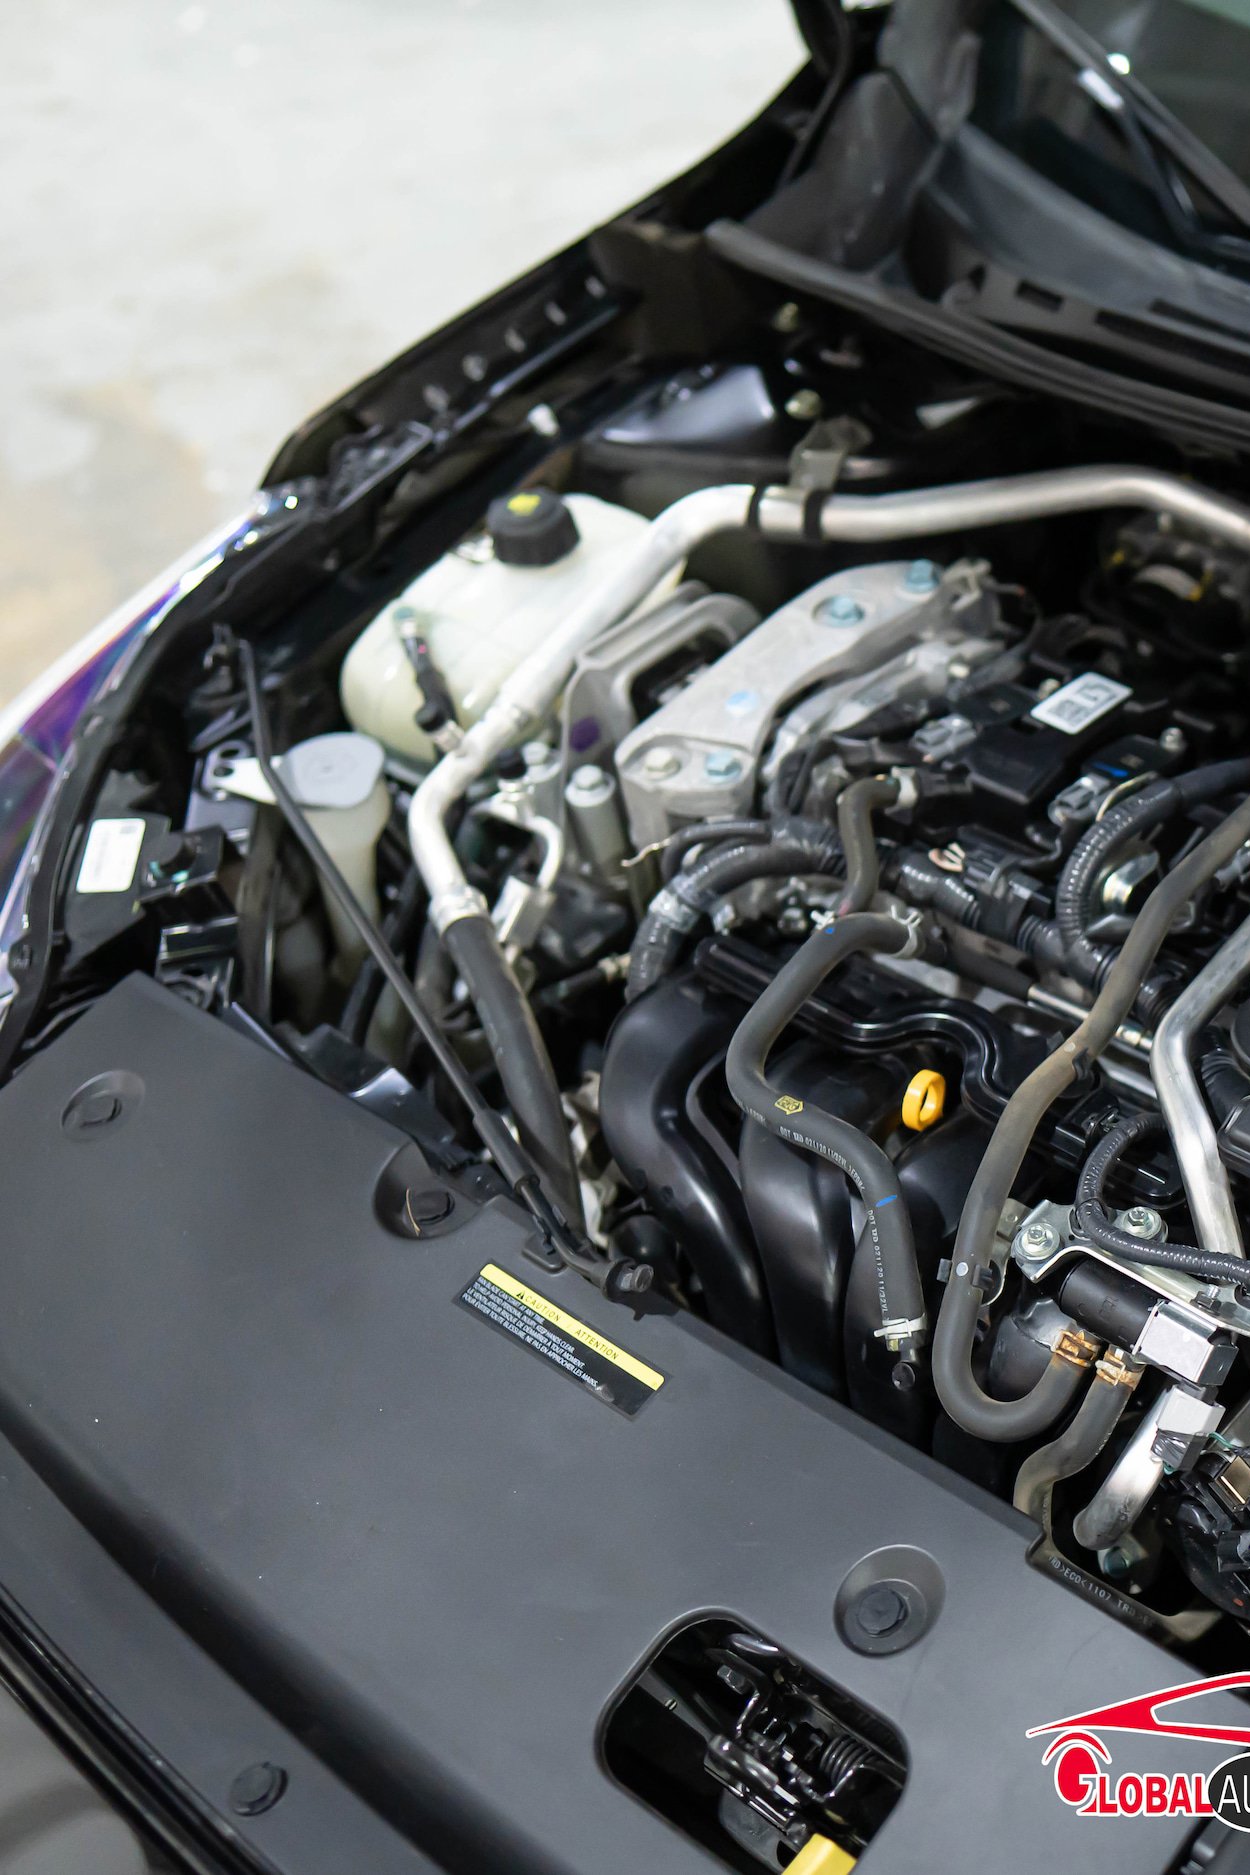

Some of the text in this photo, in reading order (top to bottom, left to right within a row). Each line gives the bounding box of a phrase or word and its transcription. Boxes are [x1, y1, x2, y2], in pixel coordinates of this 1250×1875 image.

[867, 1210, 877, 1227] DOT
[467, 1287, 475, 1295] LE
[473, 1291, 502, 1313] VENTILATEUR
[500, 1309, 518, 1324] RISQUE
[516, 1320, 525, 1328] DE
[550, 1343, 564, 1355] TOUT
[488, 1292, 503, 1304] AVOID
[501, 1301, 523, 1318] PERSONAL
[535, 1324, 548, 1334] KEEP
[545, 1330, 562, 1344] HANDS
[498, 1290, 509, 1300] CAN
[507, 1296, 521, 1308] START
[524, 1308, 535, 1317] ANY
[526, 1295, 560, 1322] CAUTION
[575, 1328, 619, 1360] ATTENTION
[462, 1292, 477, 1305] POUR
[489, 1310, 505, 1324] TOUTE
[525, 1335, 534, 1344] NE
[531, 1339, 542, 1349] PAS
[540, 1345, 549, 1354] EN
[546, 1349, 576, 1372] APPROCHER
[573, 1367, 583, 1377] LES
